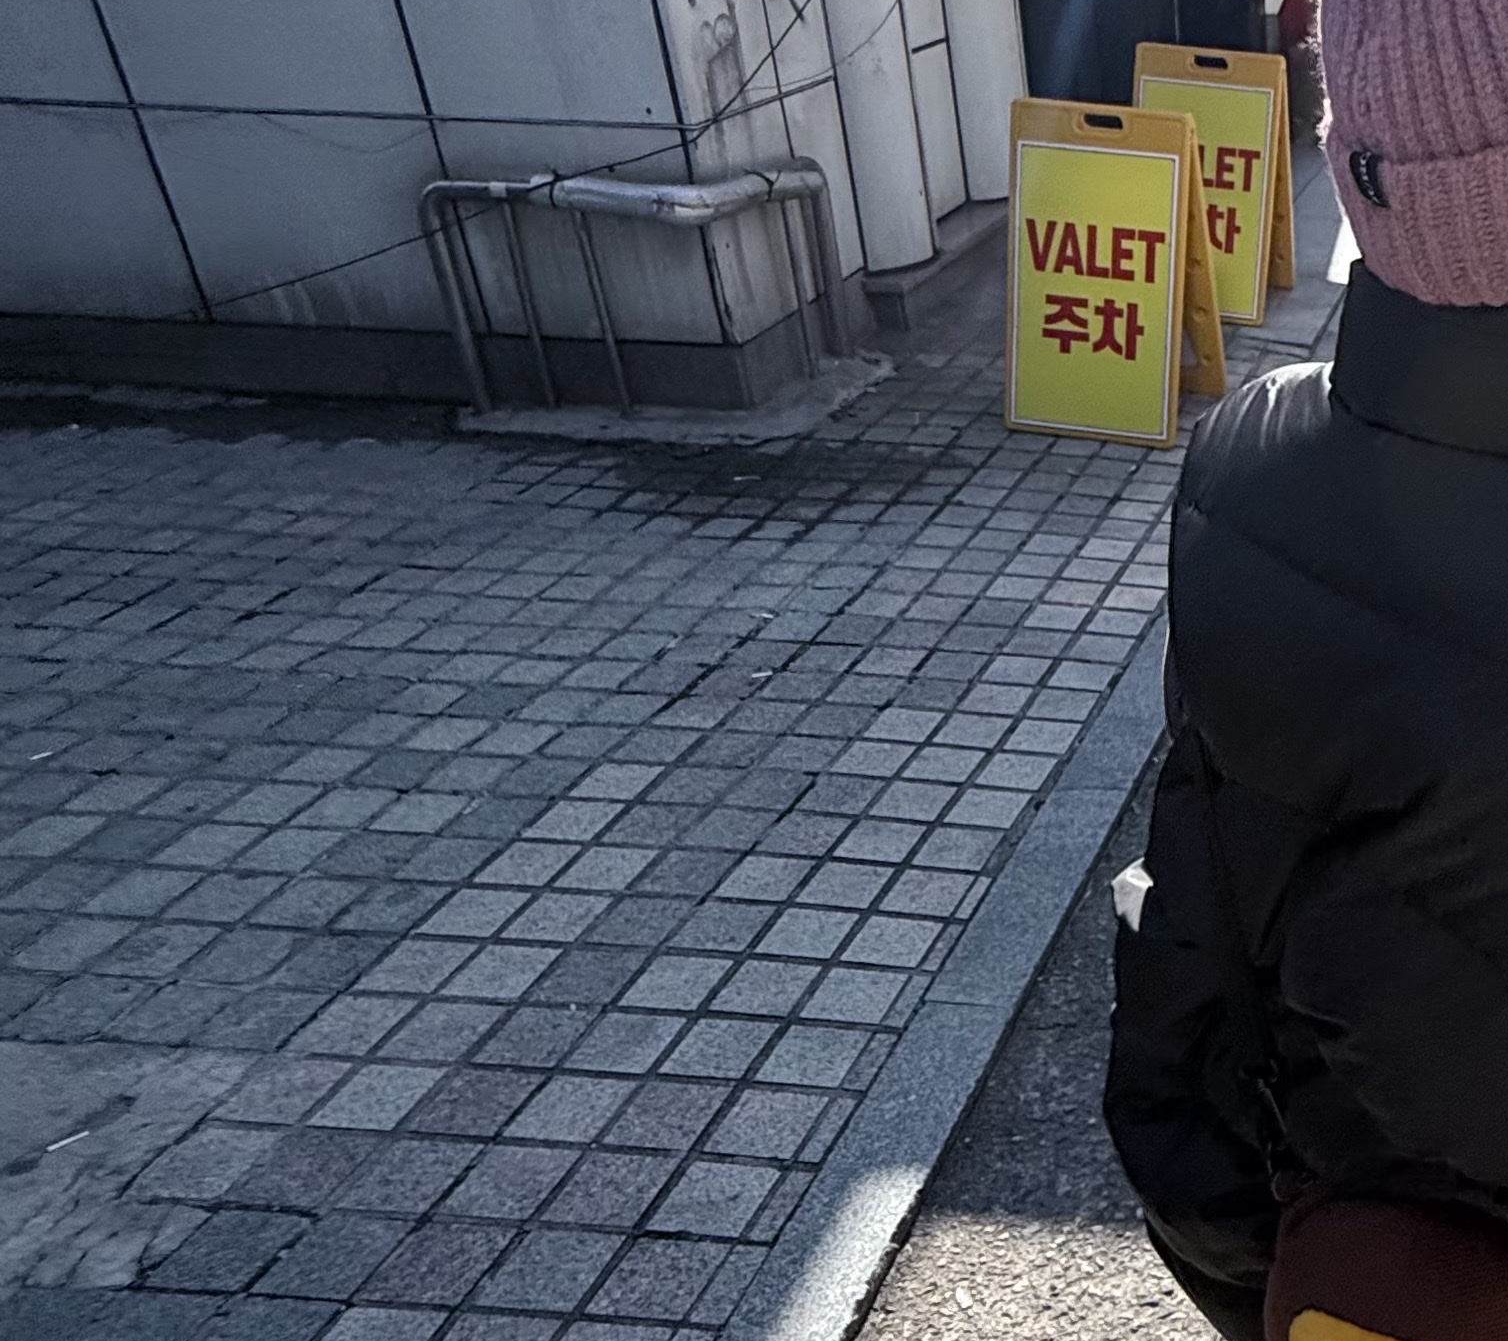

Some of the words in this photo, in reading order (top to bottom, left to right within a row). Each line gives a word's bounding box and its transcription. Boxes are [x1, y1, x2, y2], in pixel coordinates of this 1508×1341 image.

[1198, 145, 1261, 192] LET
[1025, 218, 1166, 284] VALET
[1207, 204, 1241, 254] 차
[1041, 294, 1144, 361] 주차
